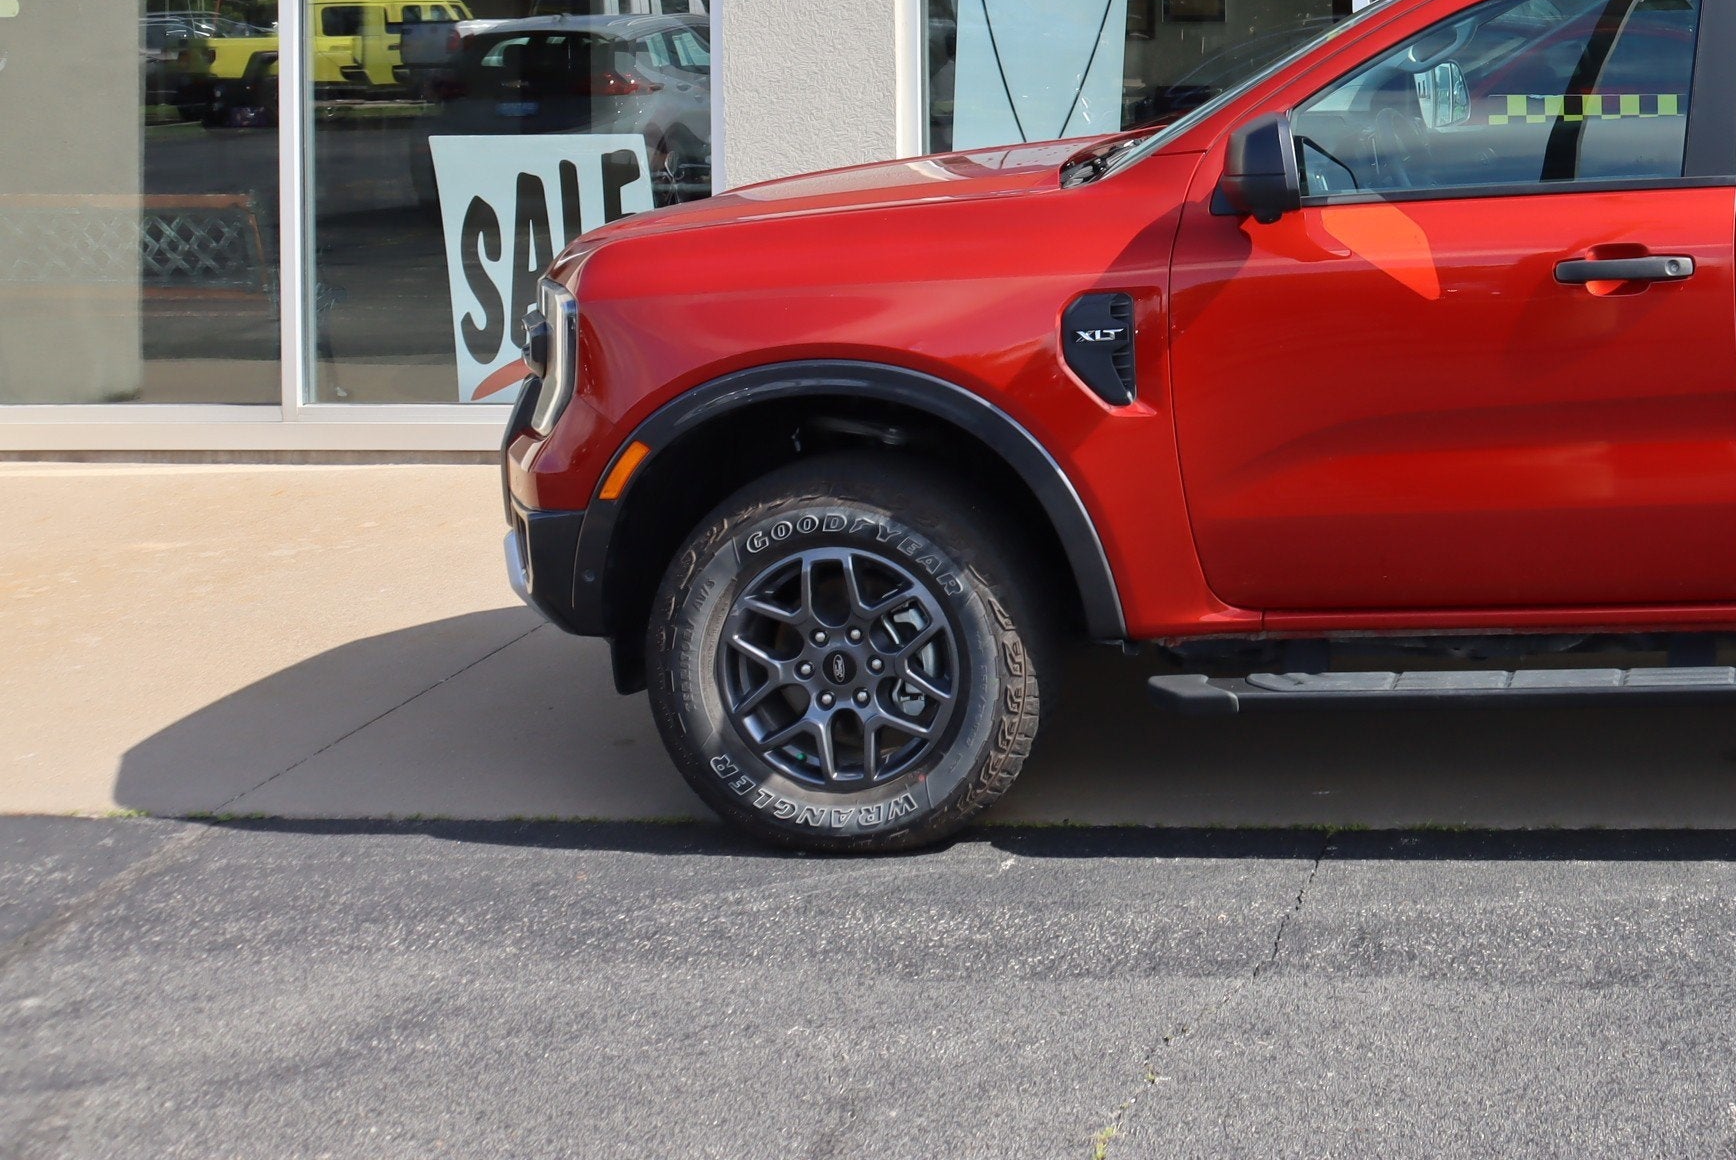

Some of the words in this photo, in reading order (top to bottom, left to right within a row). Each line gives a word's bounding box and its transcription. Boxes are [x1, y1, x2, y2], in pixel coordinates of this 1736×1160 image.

[1075, 328, 1124, 343] XLT
[745, 513, 963, 597] GOODYEAR
[710, 753, 917, 829] WRANGLER
